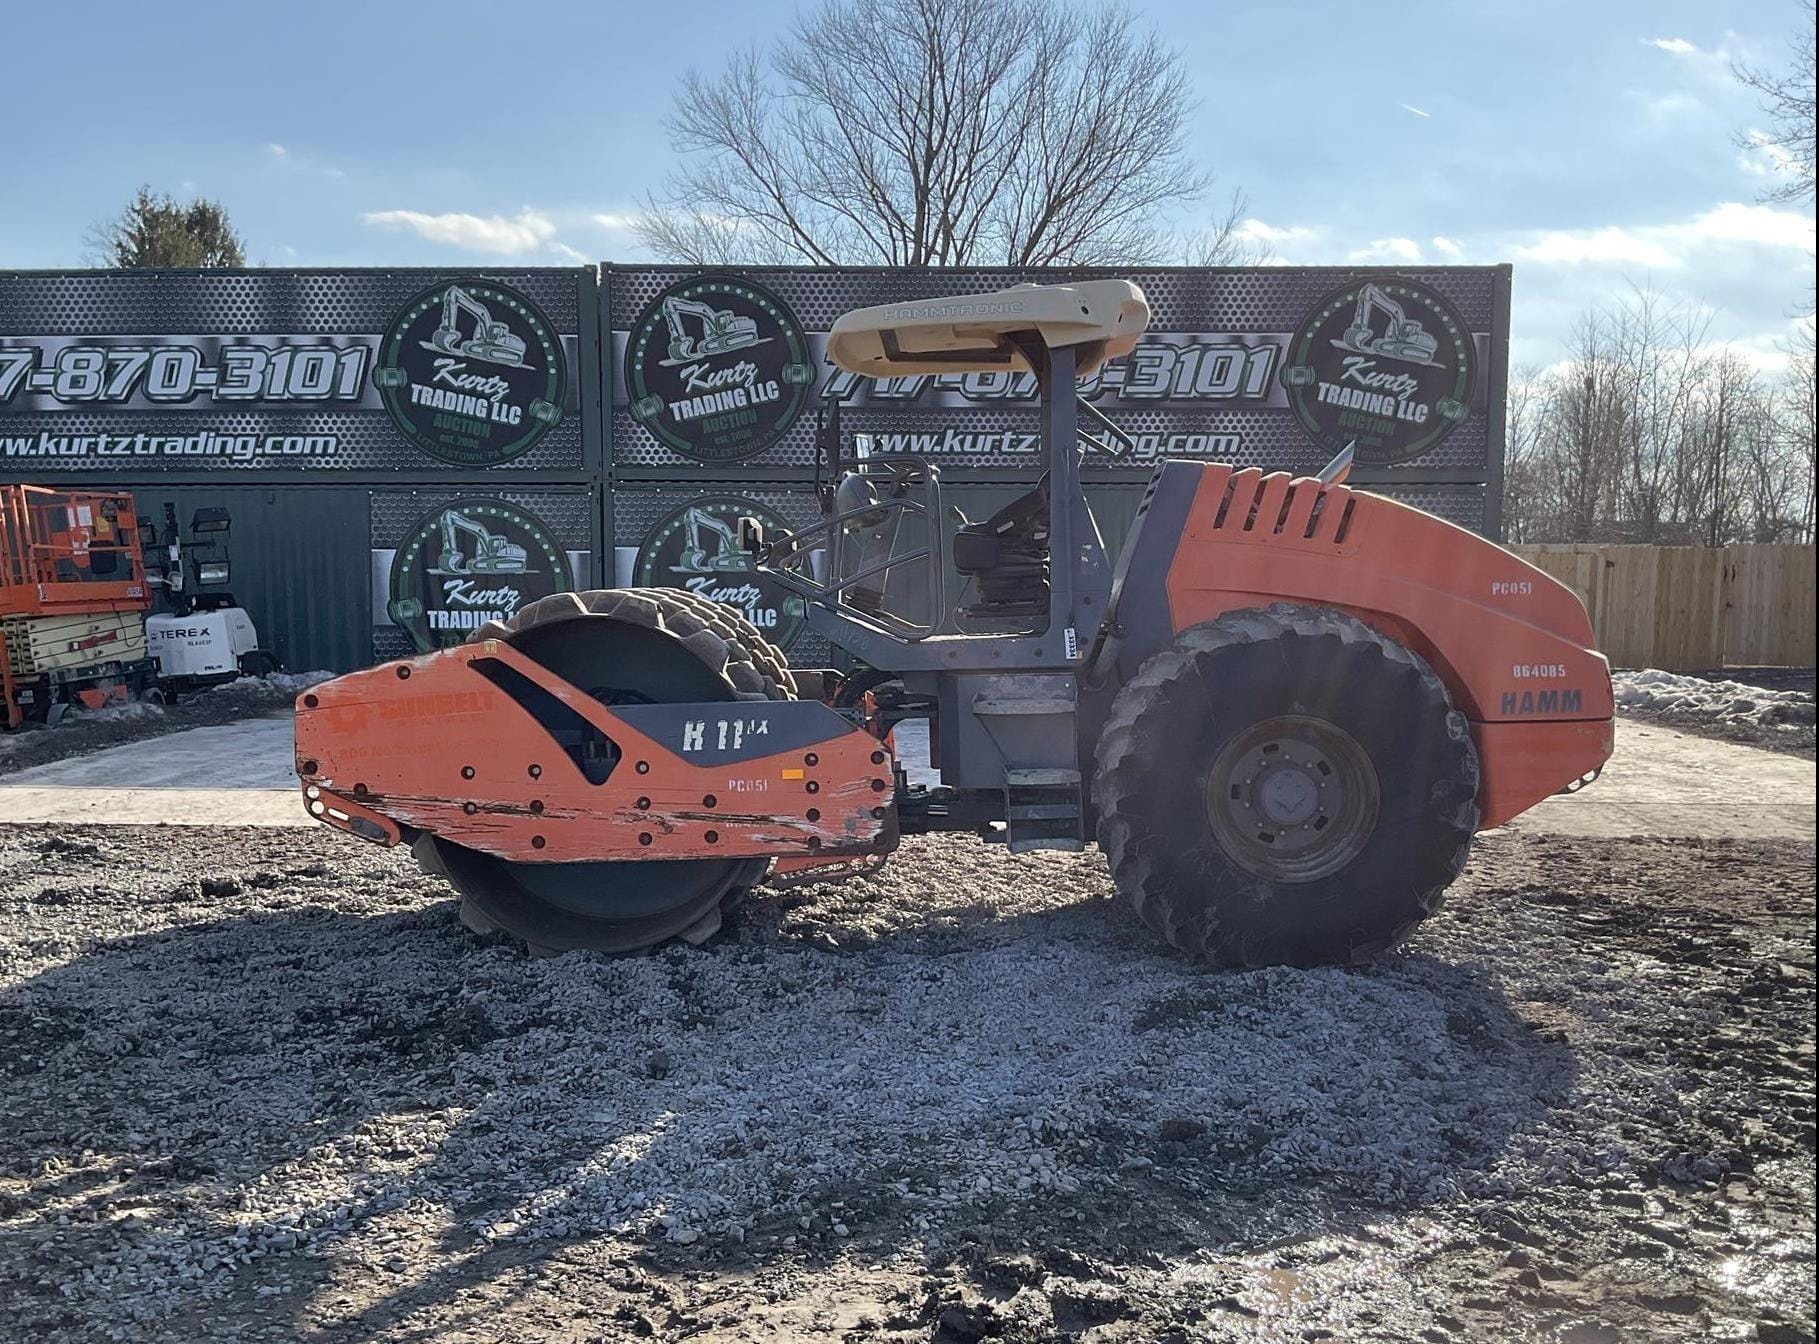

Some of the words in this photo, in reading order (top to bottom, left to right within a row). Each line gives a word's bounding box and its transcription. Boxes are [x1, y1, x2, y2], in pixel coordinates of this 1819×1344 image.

[884, 301, 1024, 321] HAMMTRONIC
[432, 358, 510, 402] Kurtz
[680, 361, 758, 393] Kurtz
[1340, 356, 1418, 400] Kurtz
[411, 384, 488, 418] TRADING
[490, 402, 522, 425] LLC
[669, 388, 747, 421] TRADING
[749, 380, 779, 404] LLC
[1317, 382, 1395, 416] TRADING
[1397, 400, 1428, 423] LLC
[432, 413, 491, 438] AUCTION
[703, 409, 757, 434] AUCTION
[1337, 411, 1397, 436] AUCTION
[0, 432, 337, 459] w.kurtztrading.com
[443, 579, 520, 612] Kurtz
[685, 577, 761, 609] Kurtz
[1492, 582, 1532, 595] PC051
[748, 608, 777, 627] LLC
[160, 627, 211, 639] TEREX
[1513, 665, 1566, 677] 864085
[1502, 689, 1582, 715] HAMM
[683, 720, 705, 751] H
[728, 780, 768, 792] PC051
